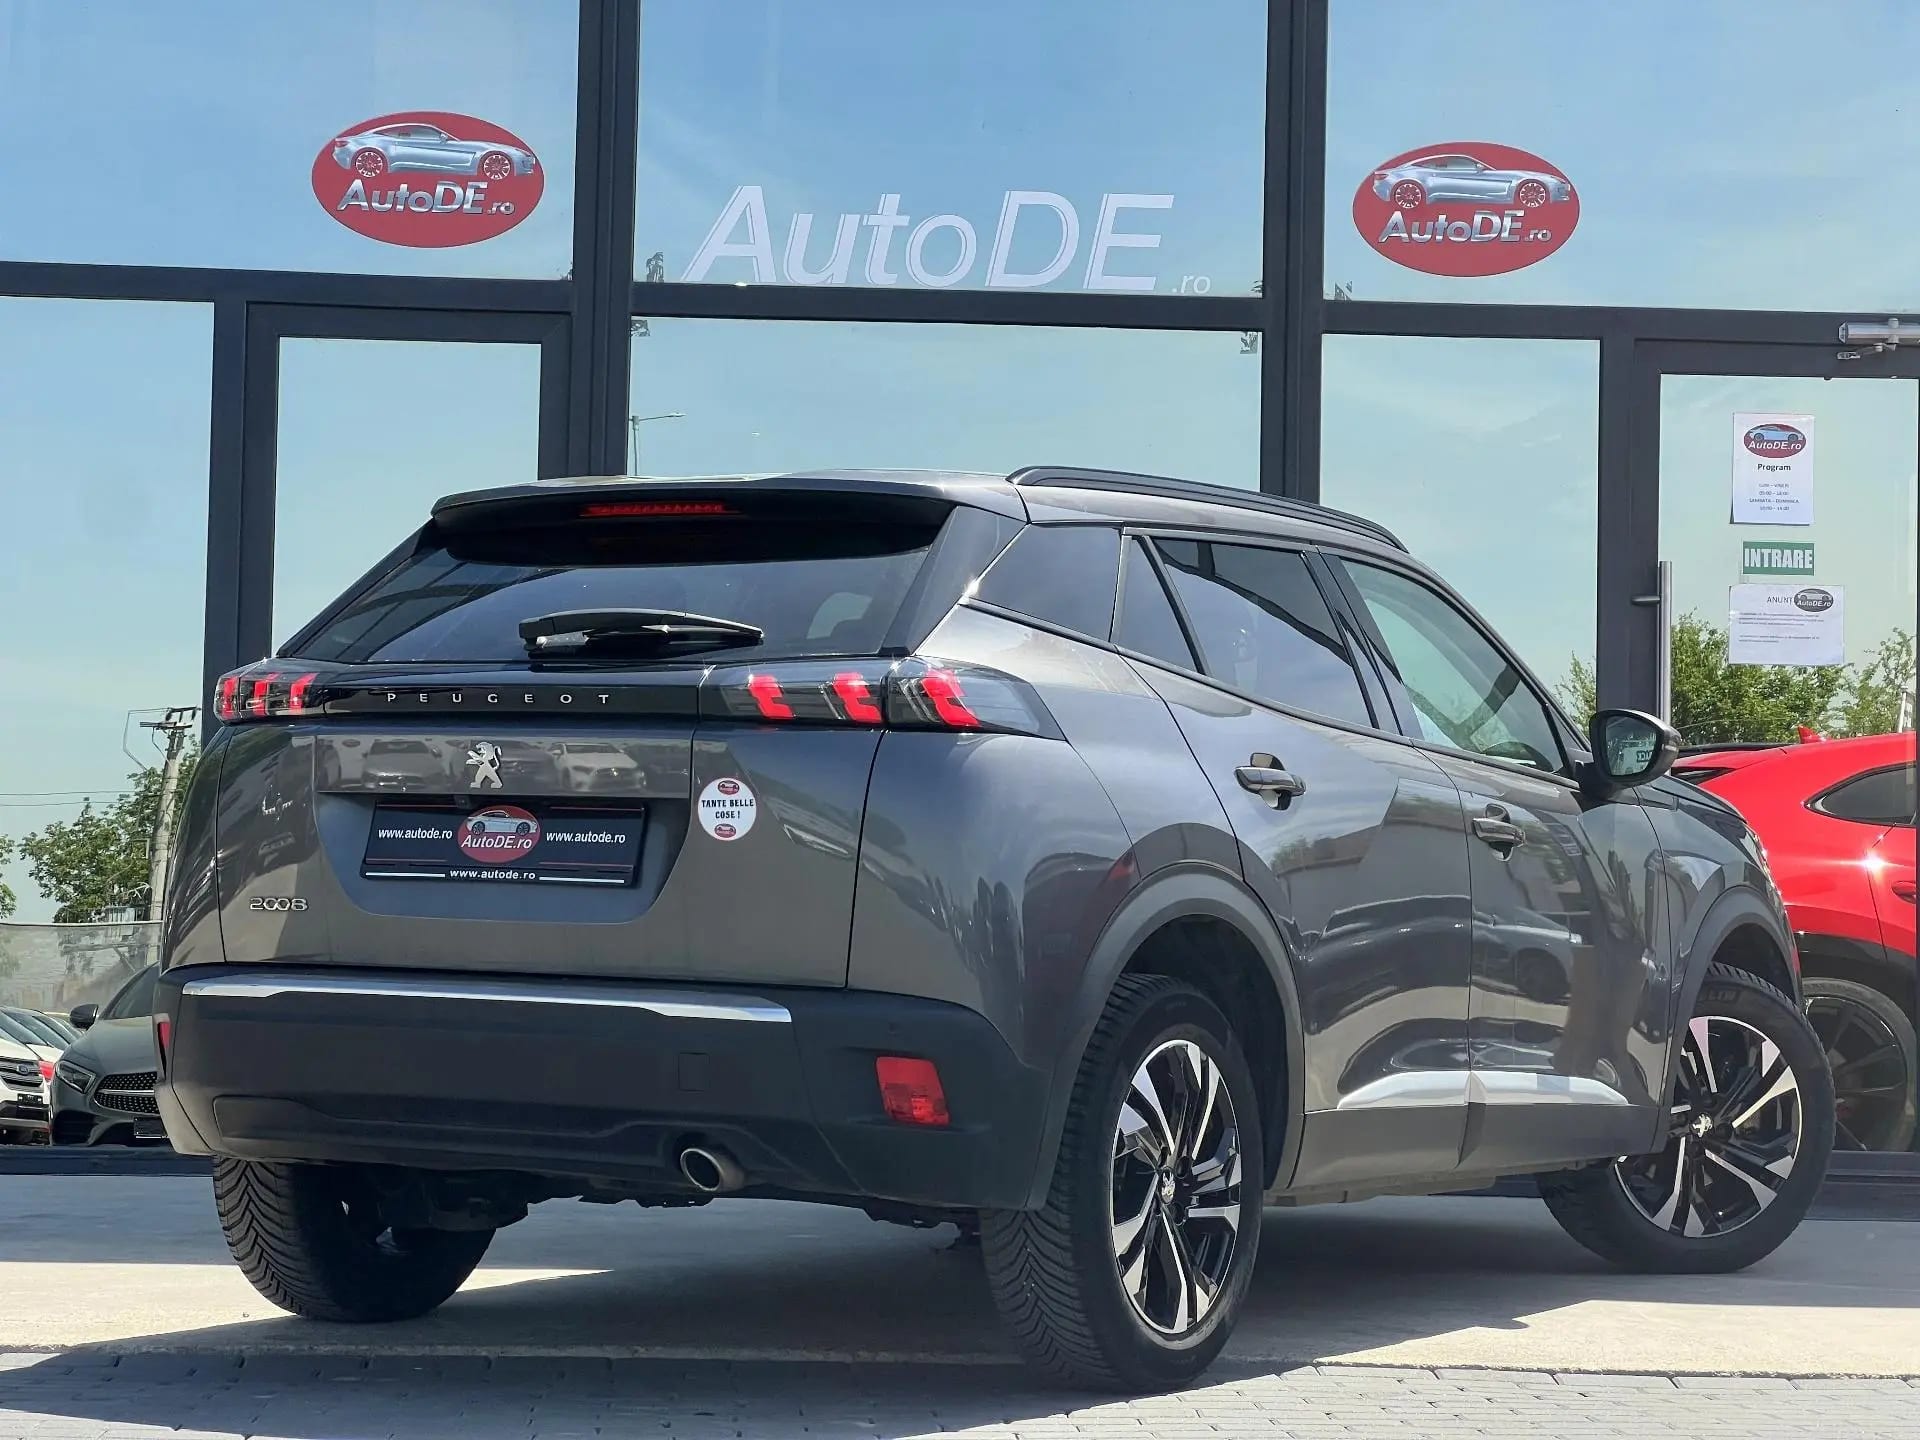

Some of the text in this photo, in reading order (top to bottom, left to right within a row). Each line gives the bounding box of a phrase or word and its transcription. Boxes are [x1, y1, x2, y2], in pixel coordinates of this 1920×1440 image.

[1747, 440, 1802, 450] AutoDE.ro
[1757, 463, 1791, 472] Program
[1744, 548, 1813, 569] INTRARE
[386, 692, 609, 704] PEUGEOT
[701, 798, 754, 808] TANTE BELLE
[377, 827, 453, 840] www.autode.ro
[545, 831, 626, 844] www.autode.ro
[460, 834, 532, 850] AutoDE.ro
[449, 868, 536, 880] www.autode.ro
[249, 897, 308, 911] 2008
